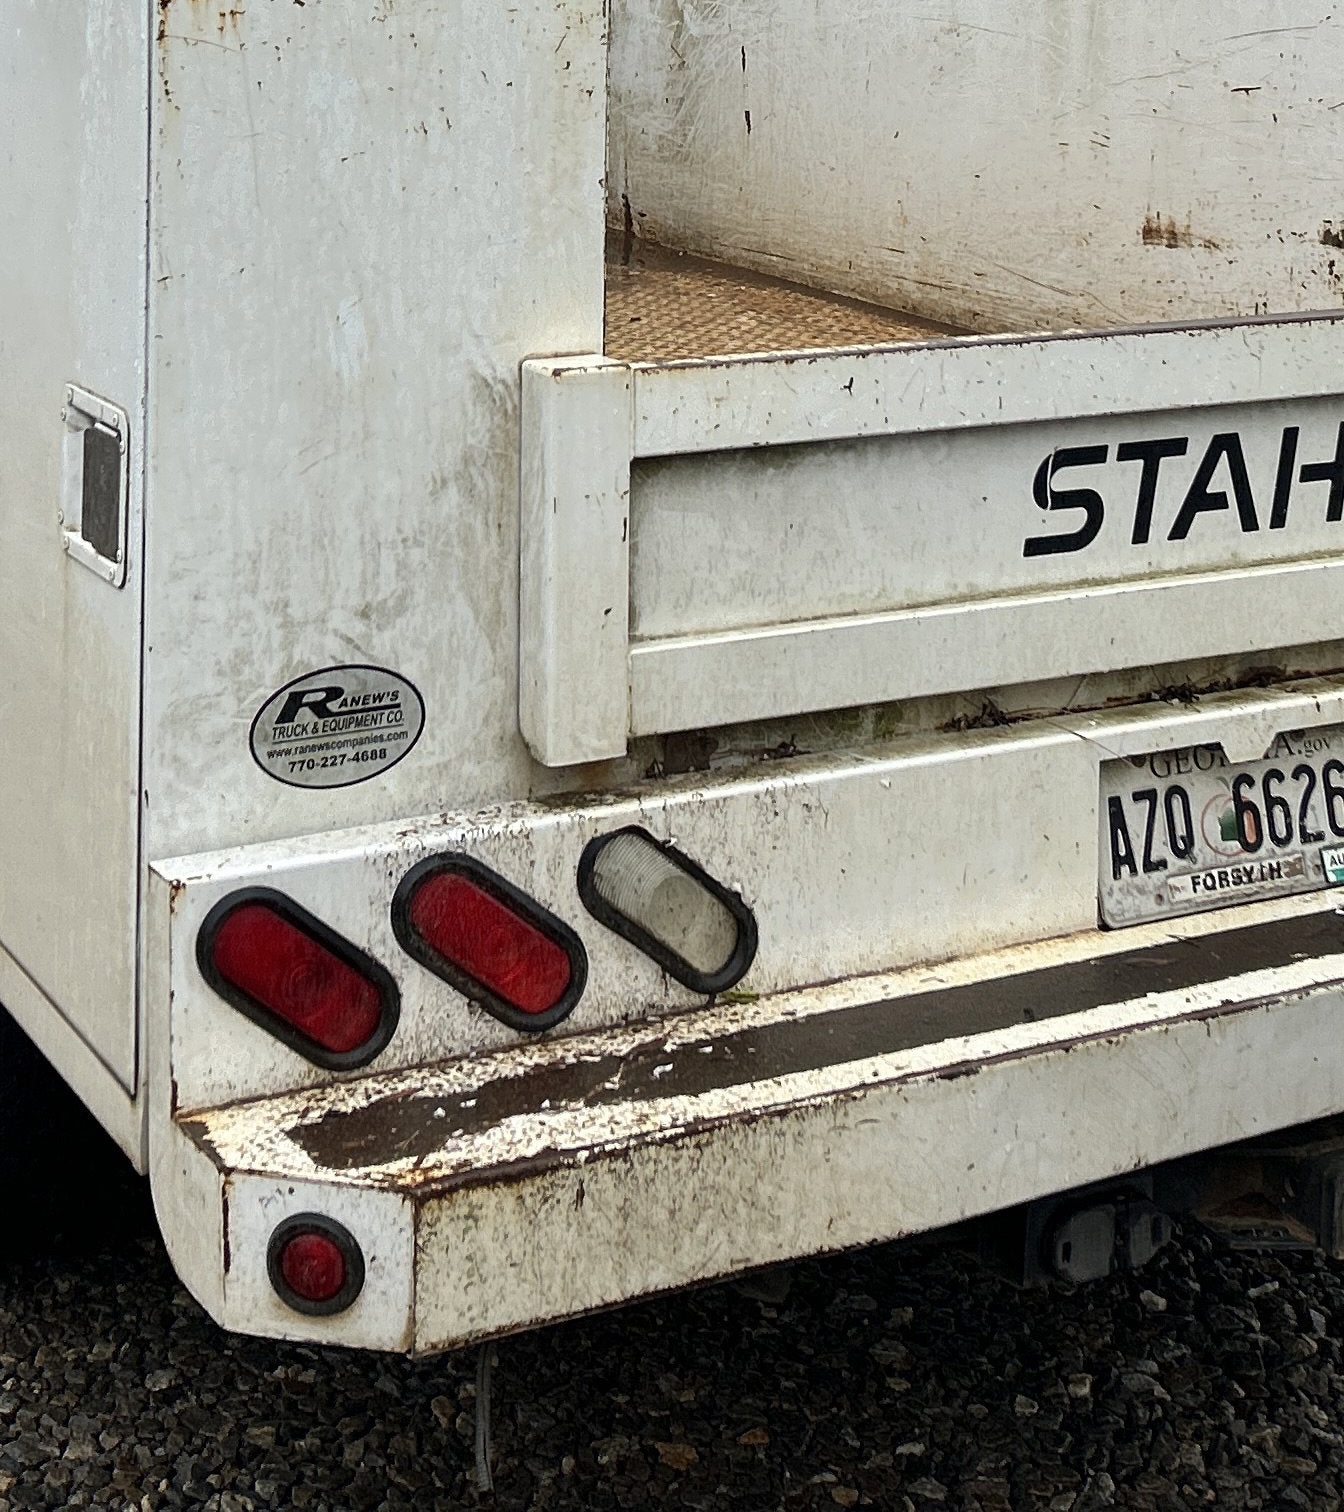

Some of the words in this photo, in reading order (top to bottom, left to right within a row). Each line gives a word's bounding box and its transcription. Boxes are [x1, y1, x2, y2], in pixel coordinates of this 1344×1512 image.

[274, 685, 400, 724] RANEW'S
[272, 721, 310, 740] TRUCK
[311, 721, 319, 735] &
[321, 711, 385, 733] EQUIPMENT
[266, 730, 410, 759] www.ranewscompanies.com
[288, 748, 387, 773] 770-227-4688
[1107, 784, 1197, 881] AZQ
